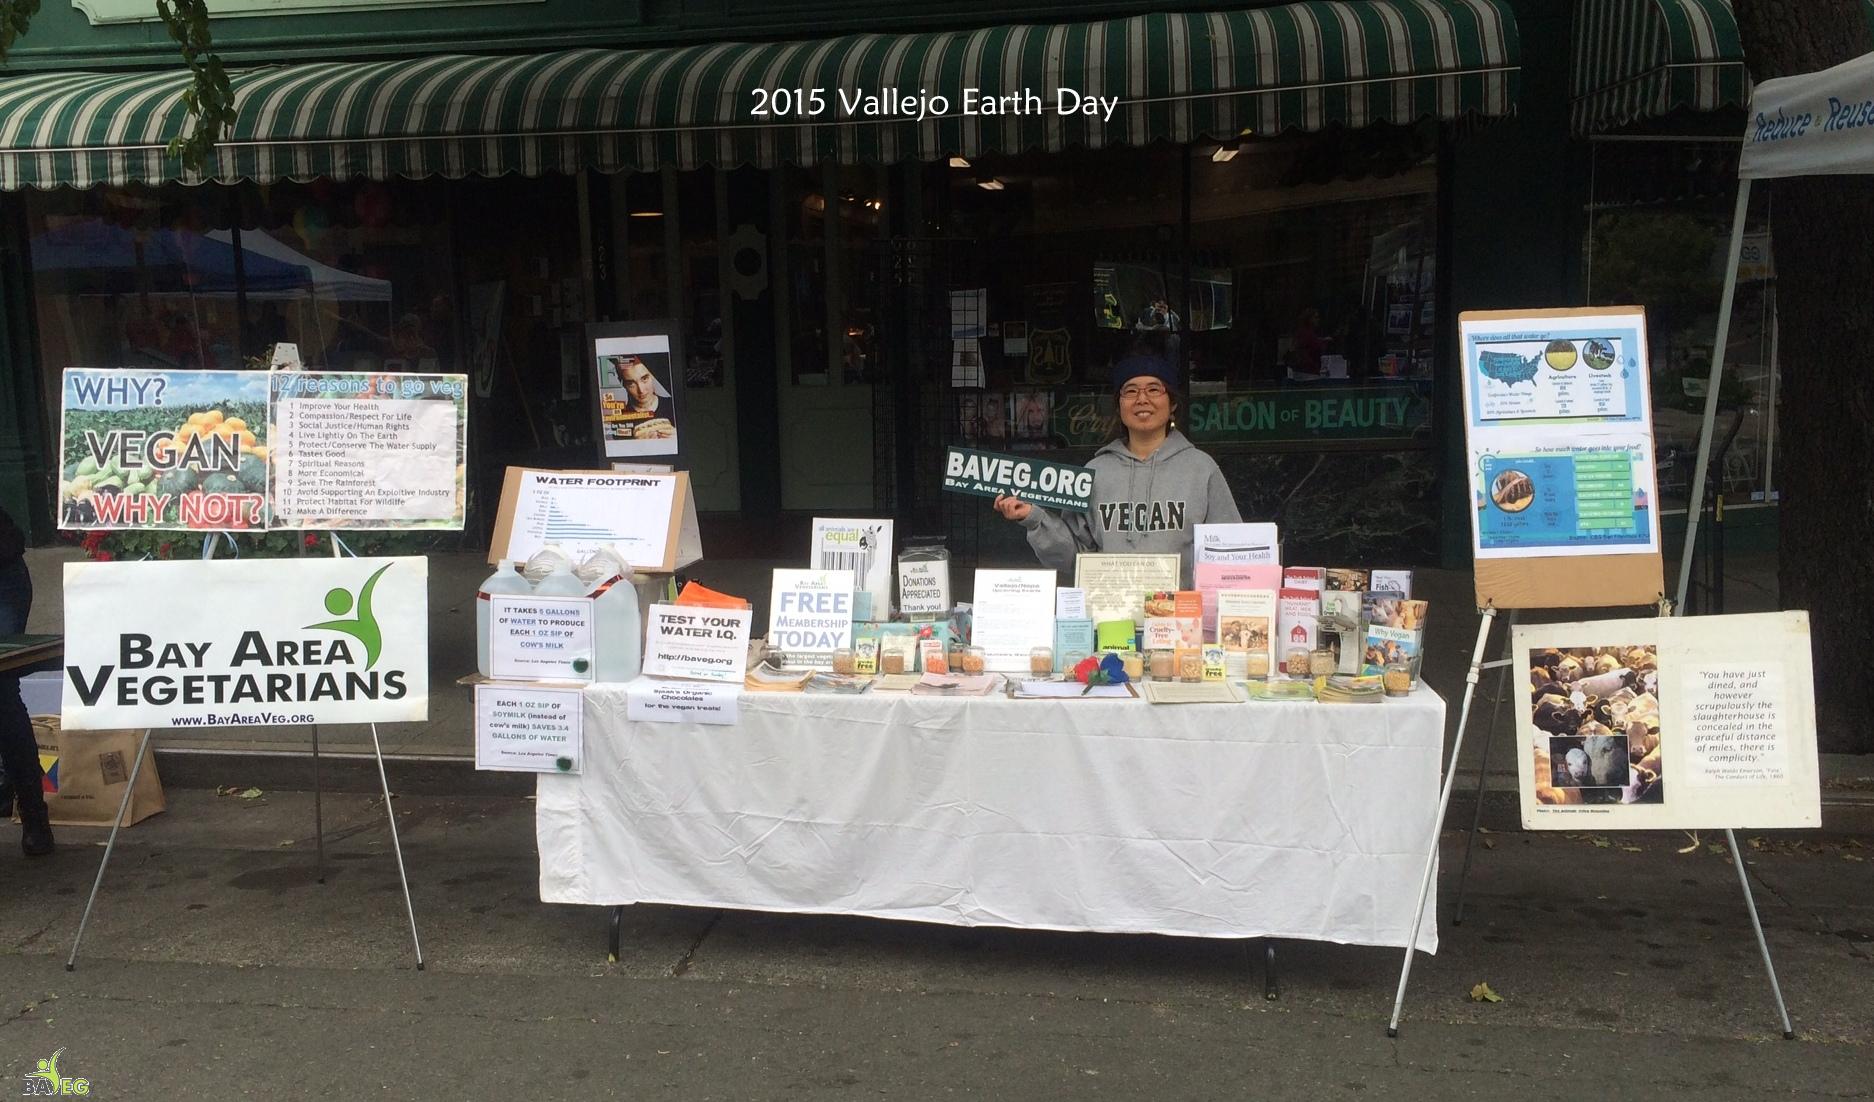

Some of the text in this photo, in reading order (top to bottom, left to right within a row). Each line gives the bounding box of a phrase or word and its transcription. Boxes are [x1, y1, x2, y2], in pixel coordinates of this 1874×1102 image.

[1753, 106, 1812, 143] Reduce
[72, 376, 169, 406] WHY?
[271, 374, 464, 398] 12 reasons to go veg
[299, 403, 332, 411] Improve
[299, 412, 379, 421] Compassion/Respect
[1188, 398, 1410, 433] SALON OF BEAUTY
[299, 421, 410, 431] Social Justice/Human Rights
[317, 432, 345, 440] Lightly
[84, 430, 241, 472] VEGAN
[298, 441, 367, 449] Protect/Conserve
[387, 442, 410, 450] Water
[412, 442, 437, 451] Supply
[946, 451, 1093, 498] BAVEG.ORG
[536, 476, 661, 487] WATER FOOTPRINT
[321, 489, 363, 498] Supporting
[378, 489, 416, 497] Exploitive
[418, 489, 449, 498] Industry
[945, 478, 1089, 508] BAY AREA VEGETARIANS
[93, 493, 265, 525] WHY NOT?
[1098, 501, 1185, 533] VEGAN
[825, 528, 859, 544] equal
[1203, 535, 1221, 543] Milk
[1204, 553, 1215, 561] Soy
[1248, 552, 1271, 560] Health
[902, 575, 936, 587] DONATIONS
[902, 588, 941, 600] APPRECIATED
[780, 592, 849, 614] FREE
[926, 603, 941, 612] you!
[660, 614, 741, 628] TEST YOUR
[776, 616, 848, 629] MEMBERSHIP
[660, 626, 737, 640] WATER I.Q.
[1375, 627, 1410, 640] Why Vegan
[773, 631, 844, 649] TODAY
[120, 631, 355, 670] BAY AREA
[658, 653, 733, 666] http://baveg.org
[1722, 670, 1745, 679] have
[1747, 670, 1766, 679] just
[66, 664, 407, 707] VEGETARIANS
[1739, 680, 1758, 689] and
[1695, 701, 1772, 711] scrupulously the
[528, 712, 556, 720] (instead
[1693, 712, 1765, 722] slaughterhouse
[1696, 722, 1743, 731] concealed
[1758, 722, 1772, 730] the
[1694, 733, 1734, 743] graceful
[1696, 744, 1706, 752] of
[1709, 744, 1736, 752] miles,
[1740, 743, 1765, 751] there
[1708, 753, 1765, 763] complicity."
